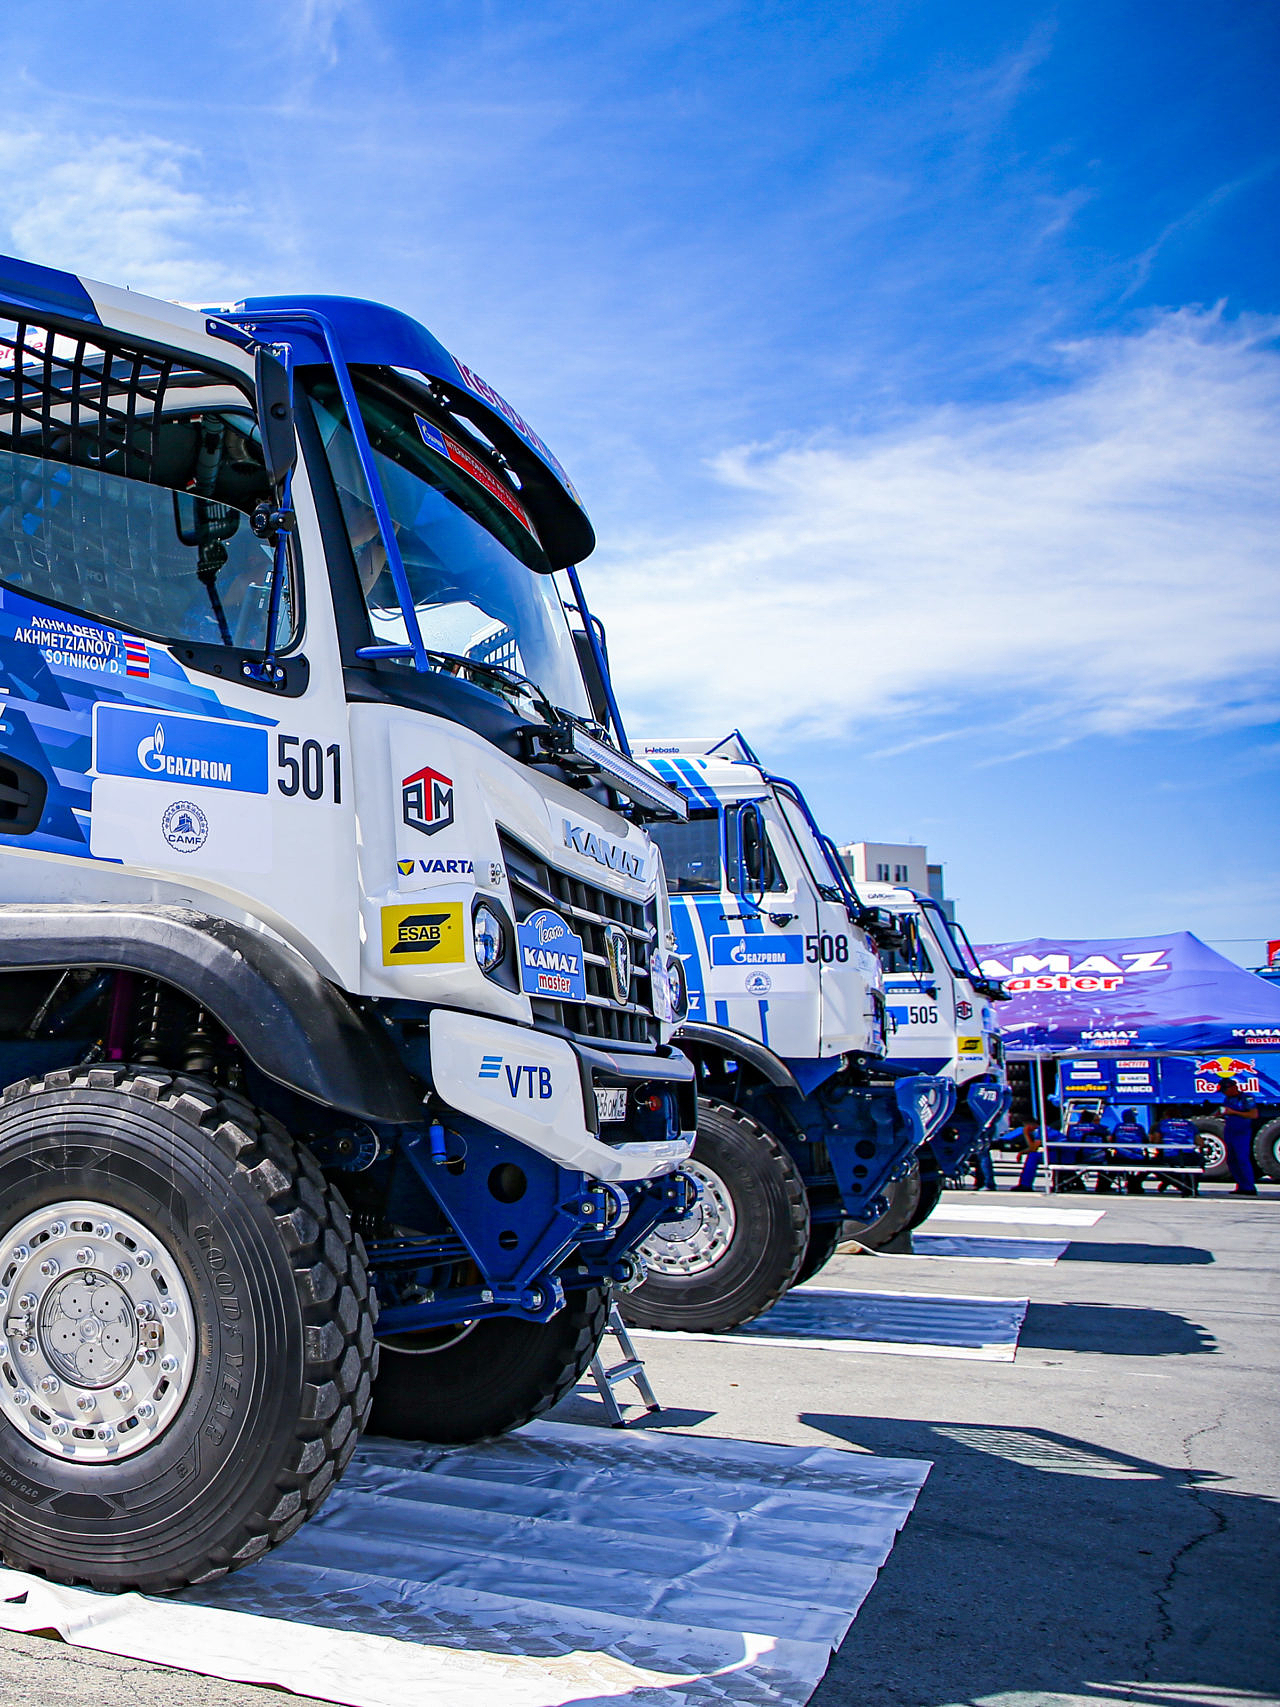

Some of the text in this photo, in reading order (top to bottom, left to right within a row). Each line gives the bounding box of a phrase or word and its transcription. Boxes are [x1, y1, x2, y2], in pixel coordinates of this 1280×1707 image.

[31, 616, 120, 645] AKHMADEEV R.
[14, 627, 122, 658] AKHMETZIANOV I.
[45, 648, 122, 674] SOTNIKOV D.
[166, 755, 232, 783] GAZPROM
[277, 734, 342, 805] 501
[168, 834, 202, 845] CAMF
[561, 817, 648, 883] KAMAZ
[419, 859, 475, 874] VARTA
[398, 926, 441, 942] ESAB
[746, 953, 787, 963] GAZPROM
[806, 934, 849, 964] 508
[523, 947, 579, 975] KAMAZ
[970, 950, 1169, 978] AMAZ
[538, 974, 571, 994] master
[1004, 974, 1124, 993] aster
[910, 1006, 938, 1025] 505
[1081, 1030, 1139, 1040] KAMAZ
[1232, 1029, 1280, 1038] KAMA
[505, 1064, 553, 1100] VTB
[1232, 1078, 1261, 1094] ull
